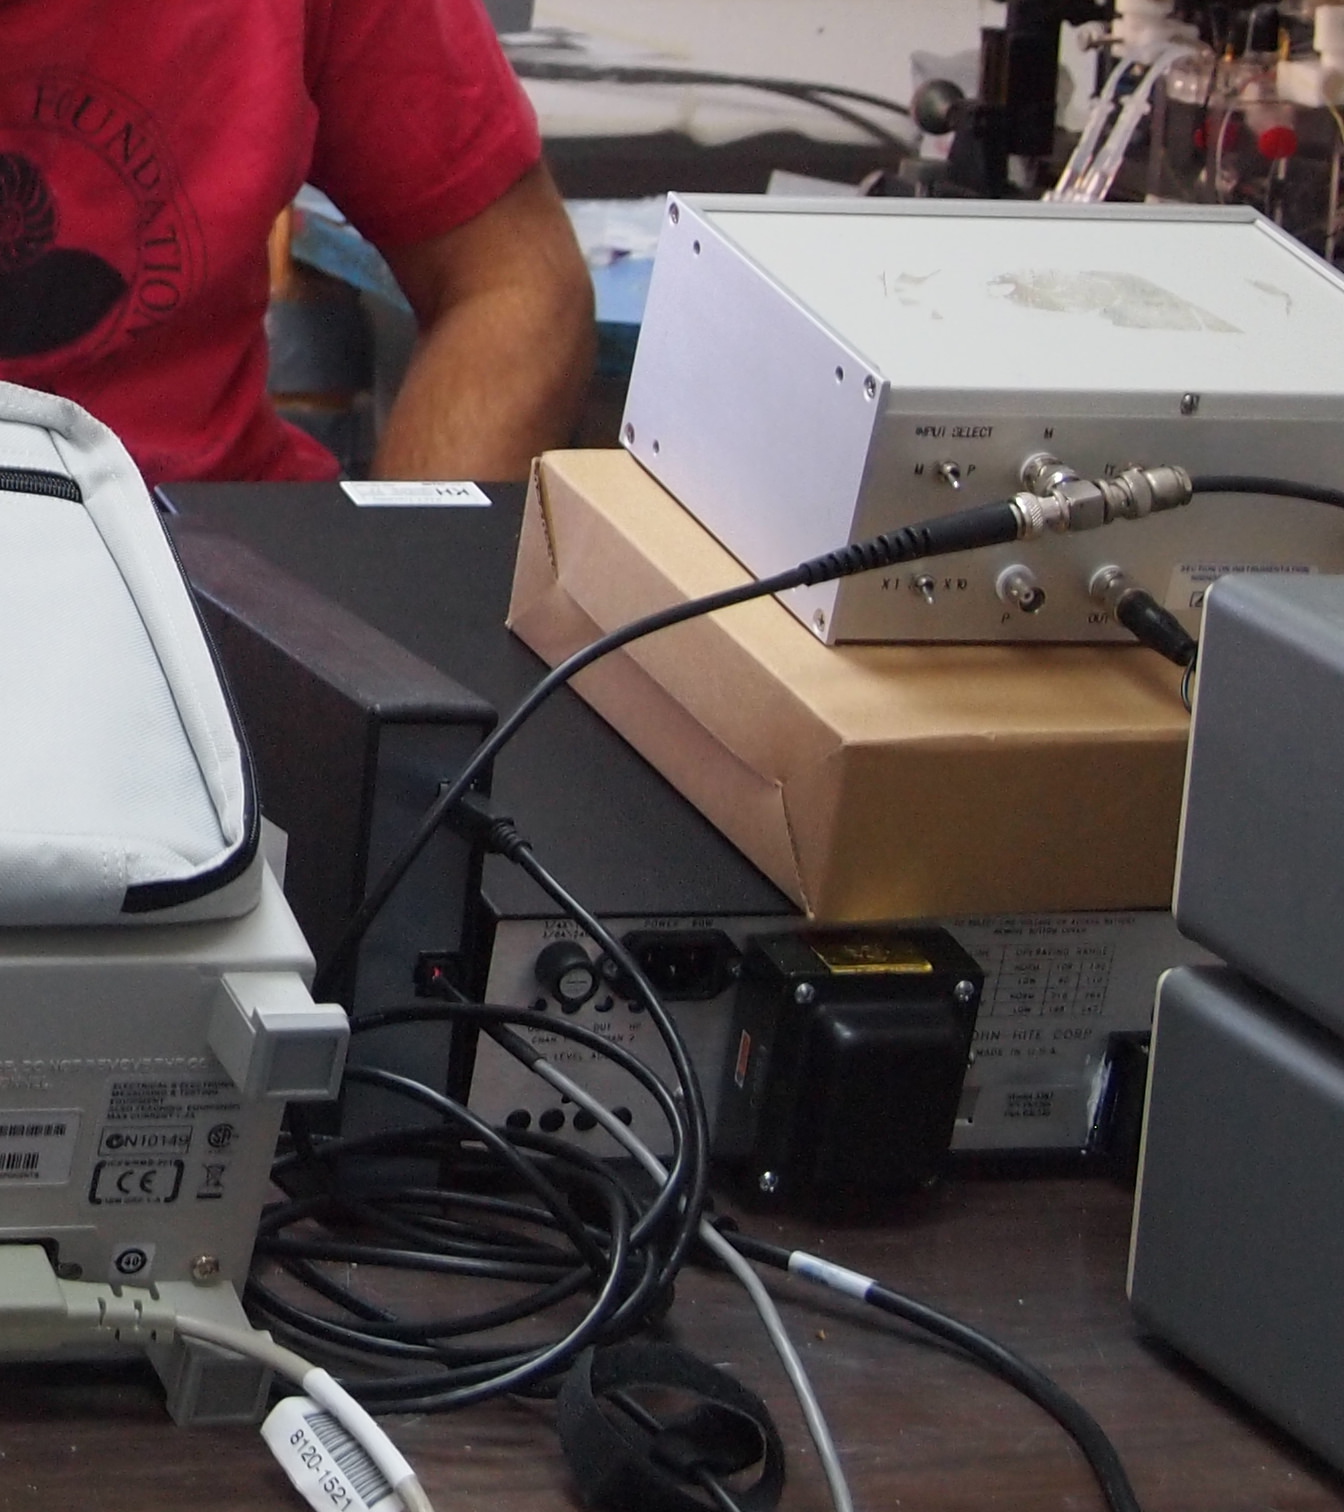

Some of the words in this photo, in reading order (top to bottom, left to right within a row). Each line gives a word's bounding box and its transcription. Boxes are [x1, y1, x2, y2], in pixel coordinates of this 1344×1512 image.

[952, 426, 993, 437] SELECT
[124, 1254, 140, 1267] 40
[289, 1428, 354, 1512] 8120-1521
